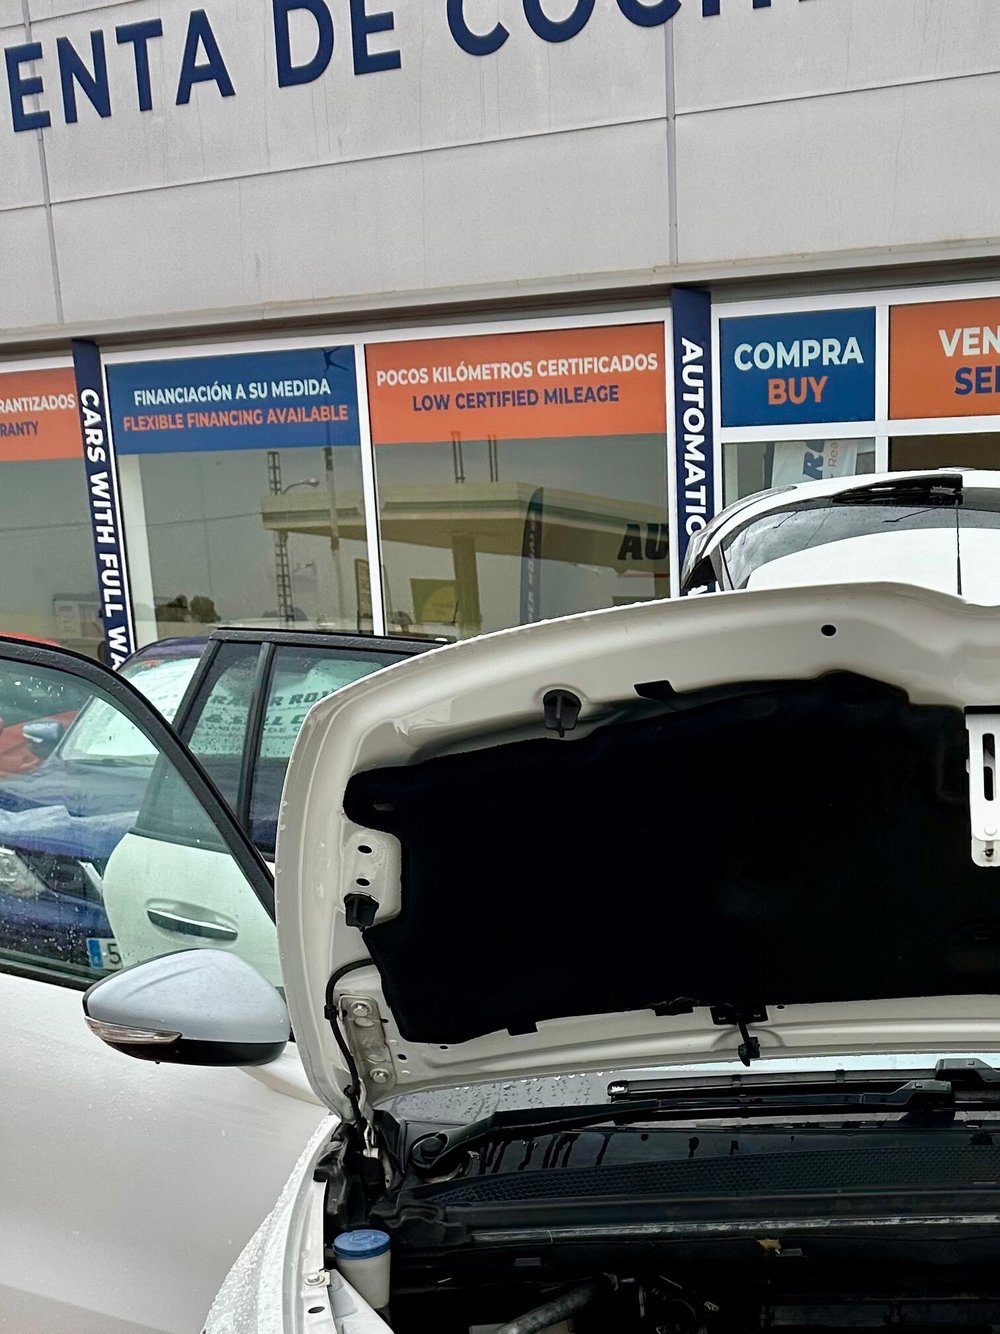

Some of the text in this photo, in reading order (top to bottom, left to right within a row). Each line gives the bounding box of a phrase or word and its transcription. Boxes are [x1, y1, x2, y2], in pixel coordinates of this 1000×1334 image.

[274, 0, 402, 88] DE
[376, 353, 659, 387] POCOS KILÓMETROS CERTIFICADOS
[734, 336, 865, 371] COMPRA
[134, 378, 331, 406] FINANCIACIÓN A SU MEDIDA
[412, 385, 620, 412] LOW CERTIFIED MILEAGE
[767, 375, 828, 405] BUY
[80, 388, 106, 463] CARS
[123, 404, 349, 432] FLEXIBLE FINANCING AVAILABLE
[681, 337, 708, 536] AUTOMATIC
[90, 471, 116, 544] WITH
[99, 552, 124, 617] FULL
